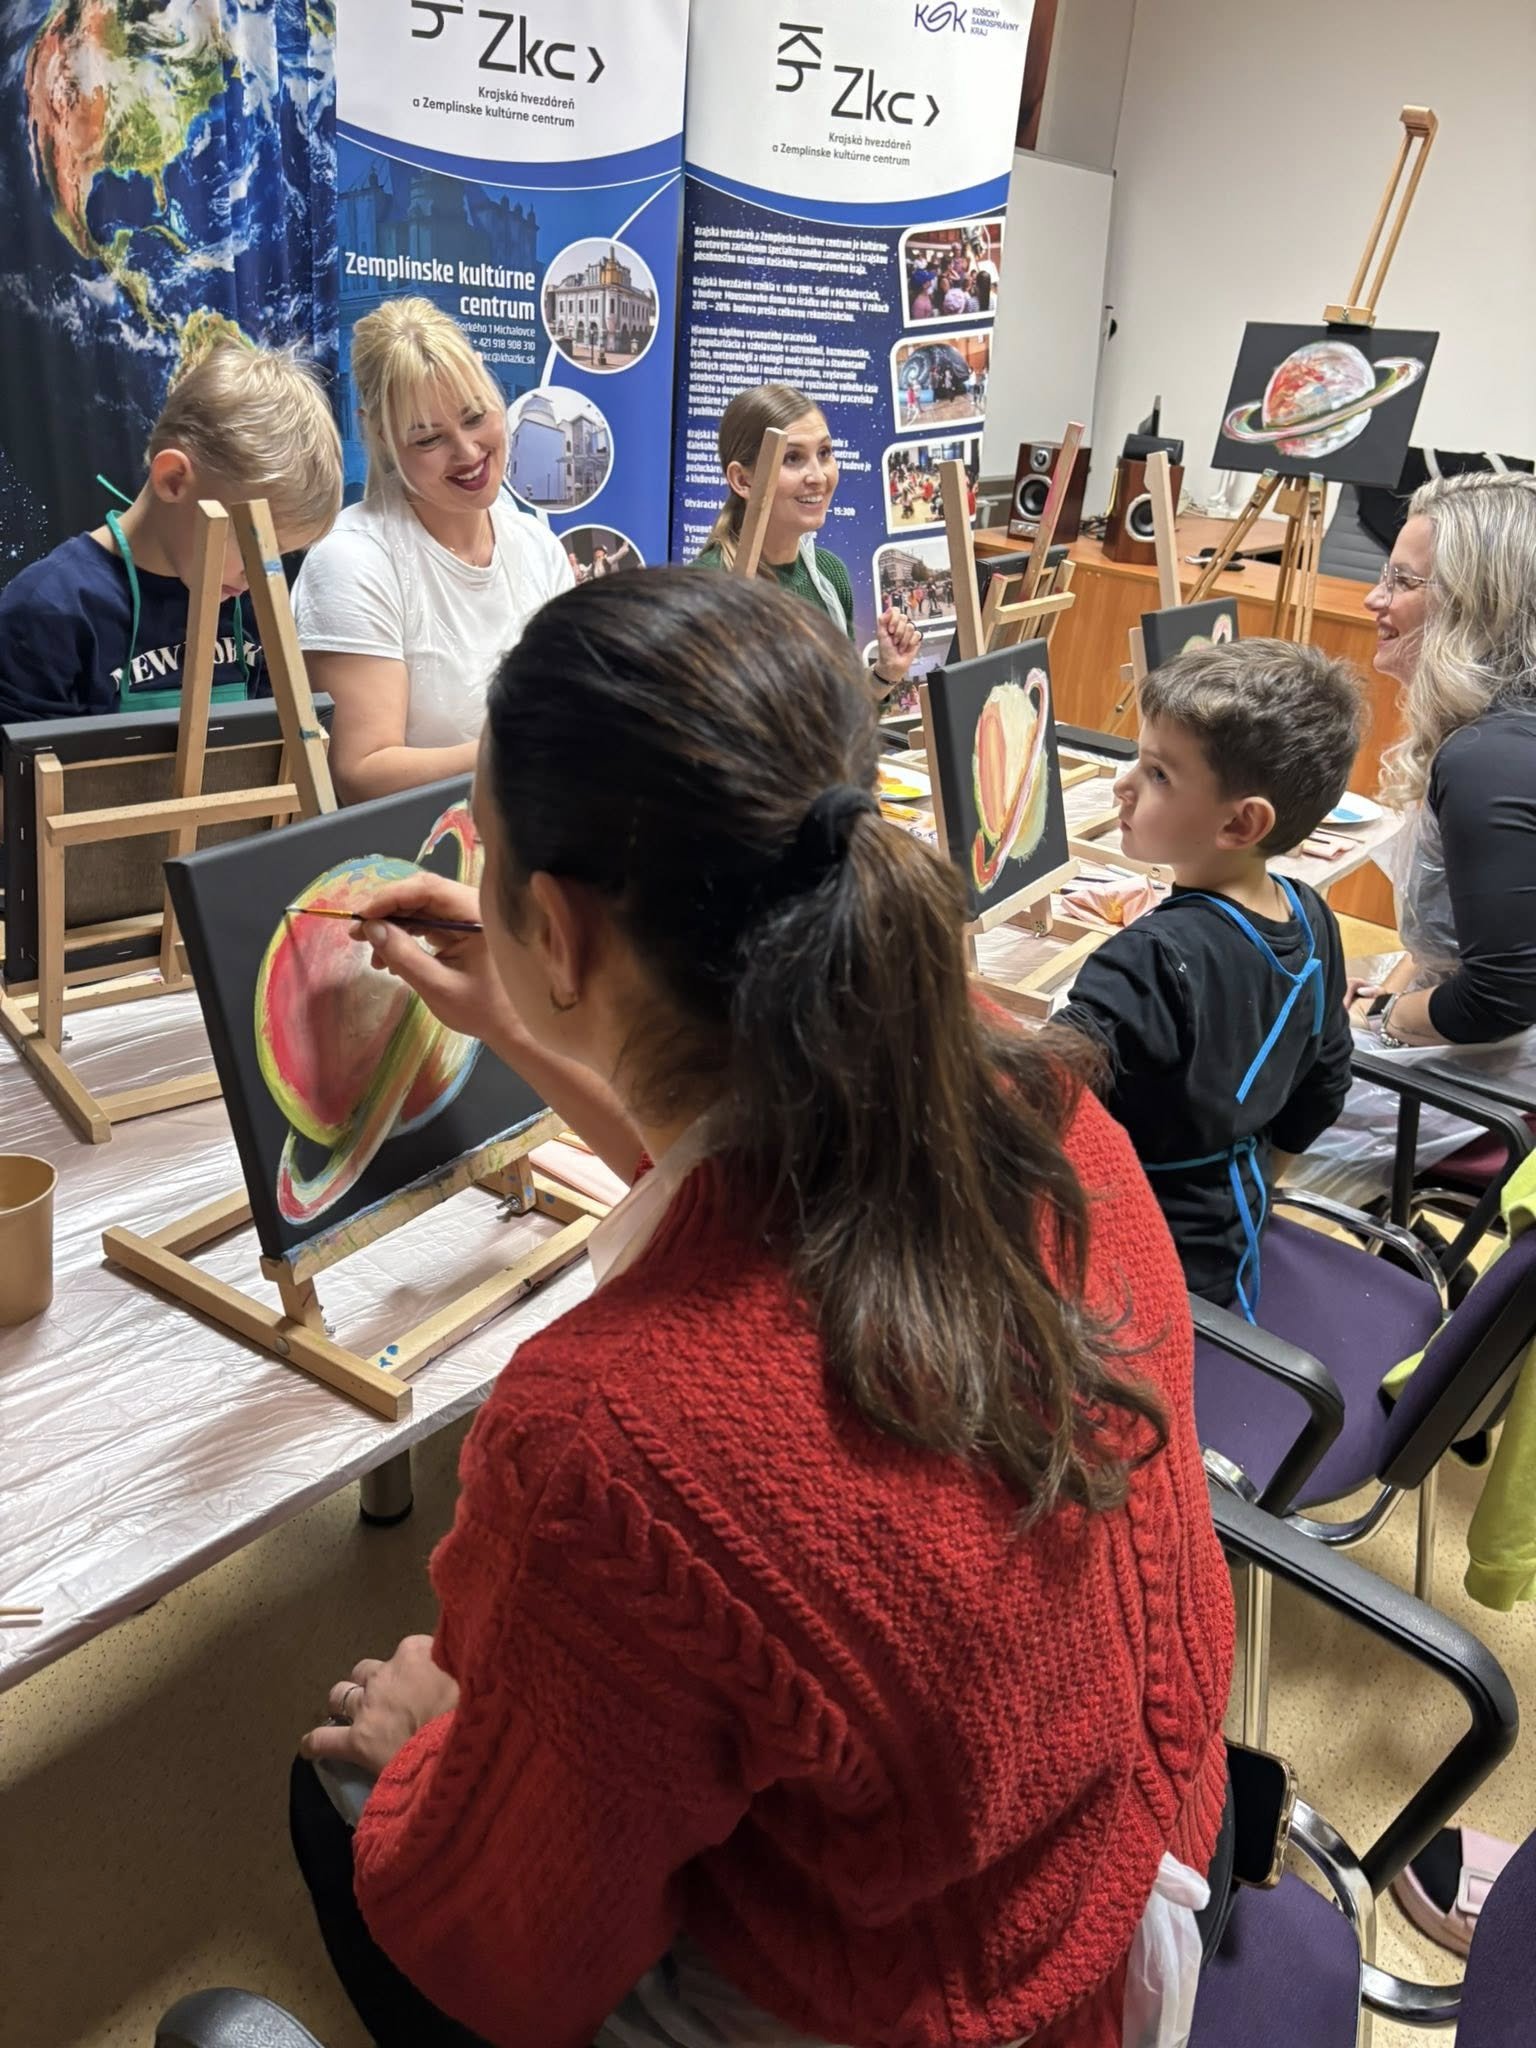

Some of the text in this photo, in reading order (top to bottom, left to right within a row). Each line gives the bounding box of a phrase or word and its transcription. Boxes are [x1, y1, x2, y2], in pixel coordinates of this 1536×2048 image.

[411, 0, 463, 39] h
[971, 17, 1019, 31] SAMOSPRÁVNY
[970, 27, 988, 36] KRAJ
[478, 10, 575, 81] Zkc
[478, 86, 575, 109] Krajská hvezdáreň
[831, 65, 915, 125] Zkc
[412, 97, 574, 127] a Zemplínske kultúrne centrum
[828, 132, 911, 150] Krajská hvezdáreň
[780, 143, 831, 158] Zemplínske
[834, 149, 871, 162] kultúrne
[872, 155, 910, 166] centrum
[345, 252, 535, 291] Zemplínske kultúrne
[460, 296, 535, 320] centrum
[494, 325, 536, 337] Michalovce
[479, 337, 492, 347] 421
[492, 339, 506, 349] 918
[507, 340, 522, 350] 908
[523, 341, 536, 351] 310
